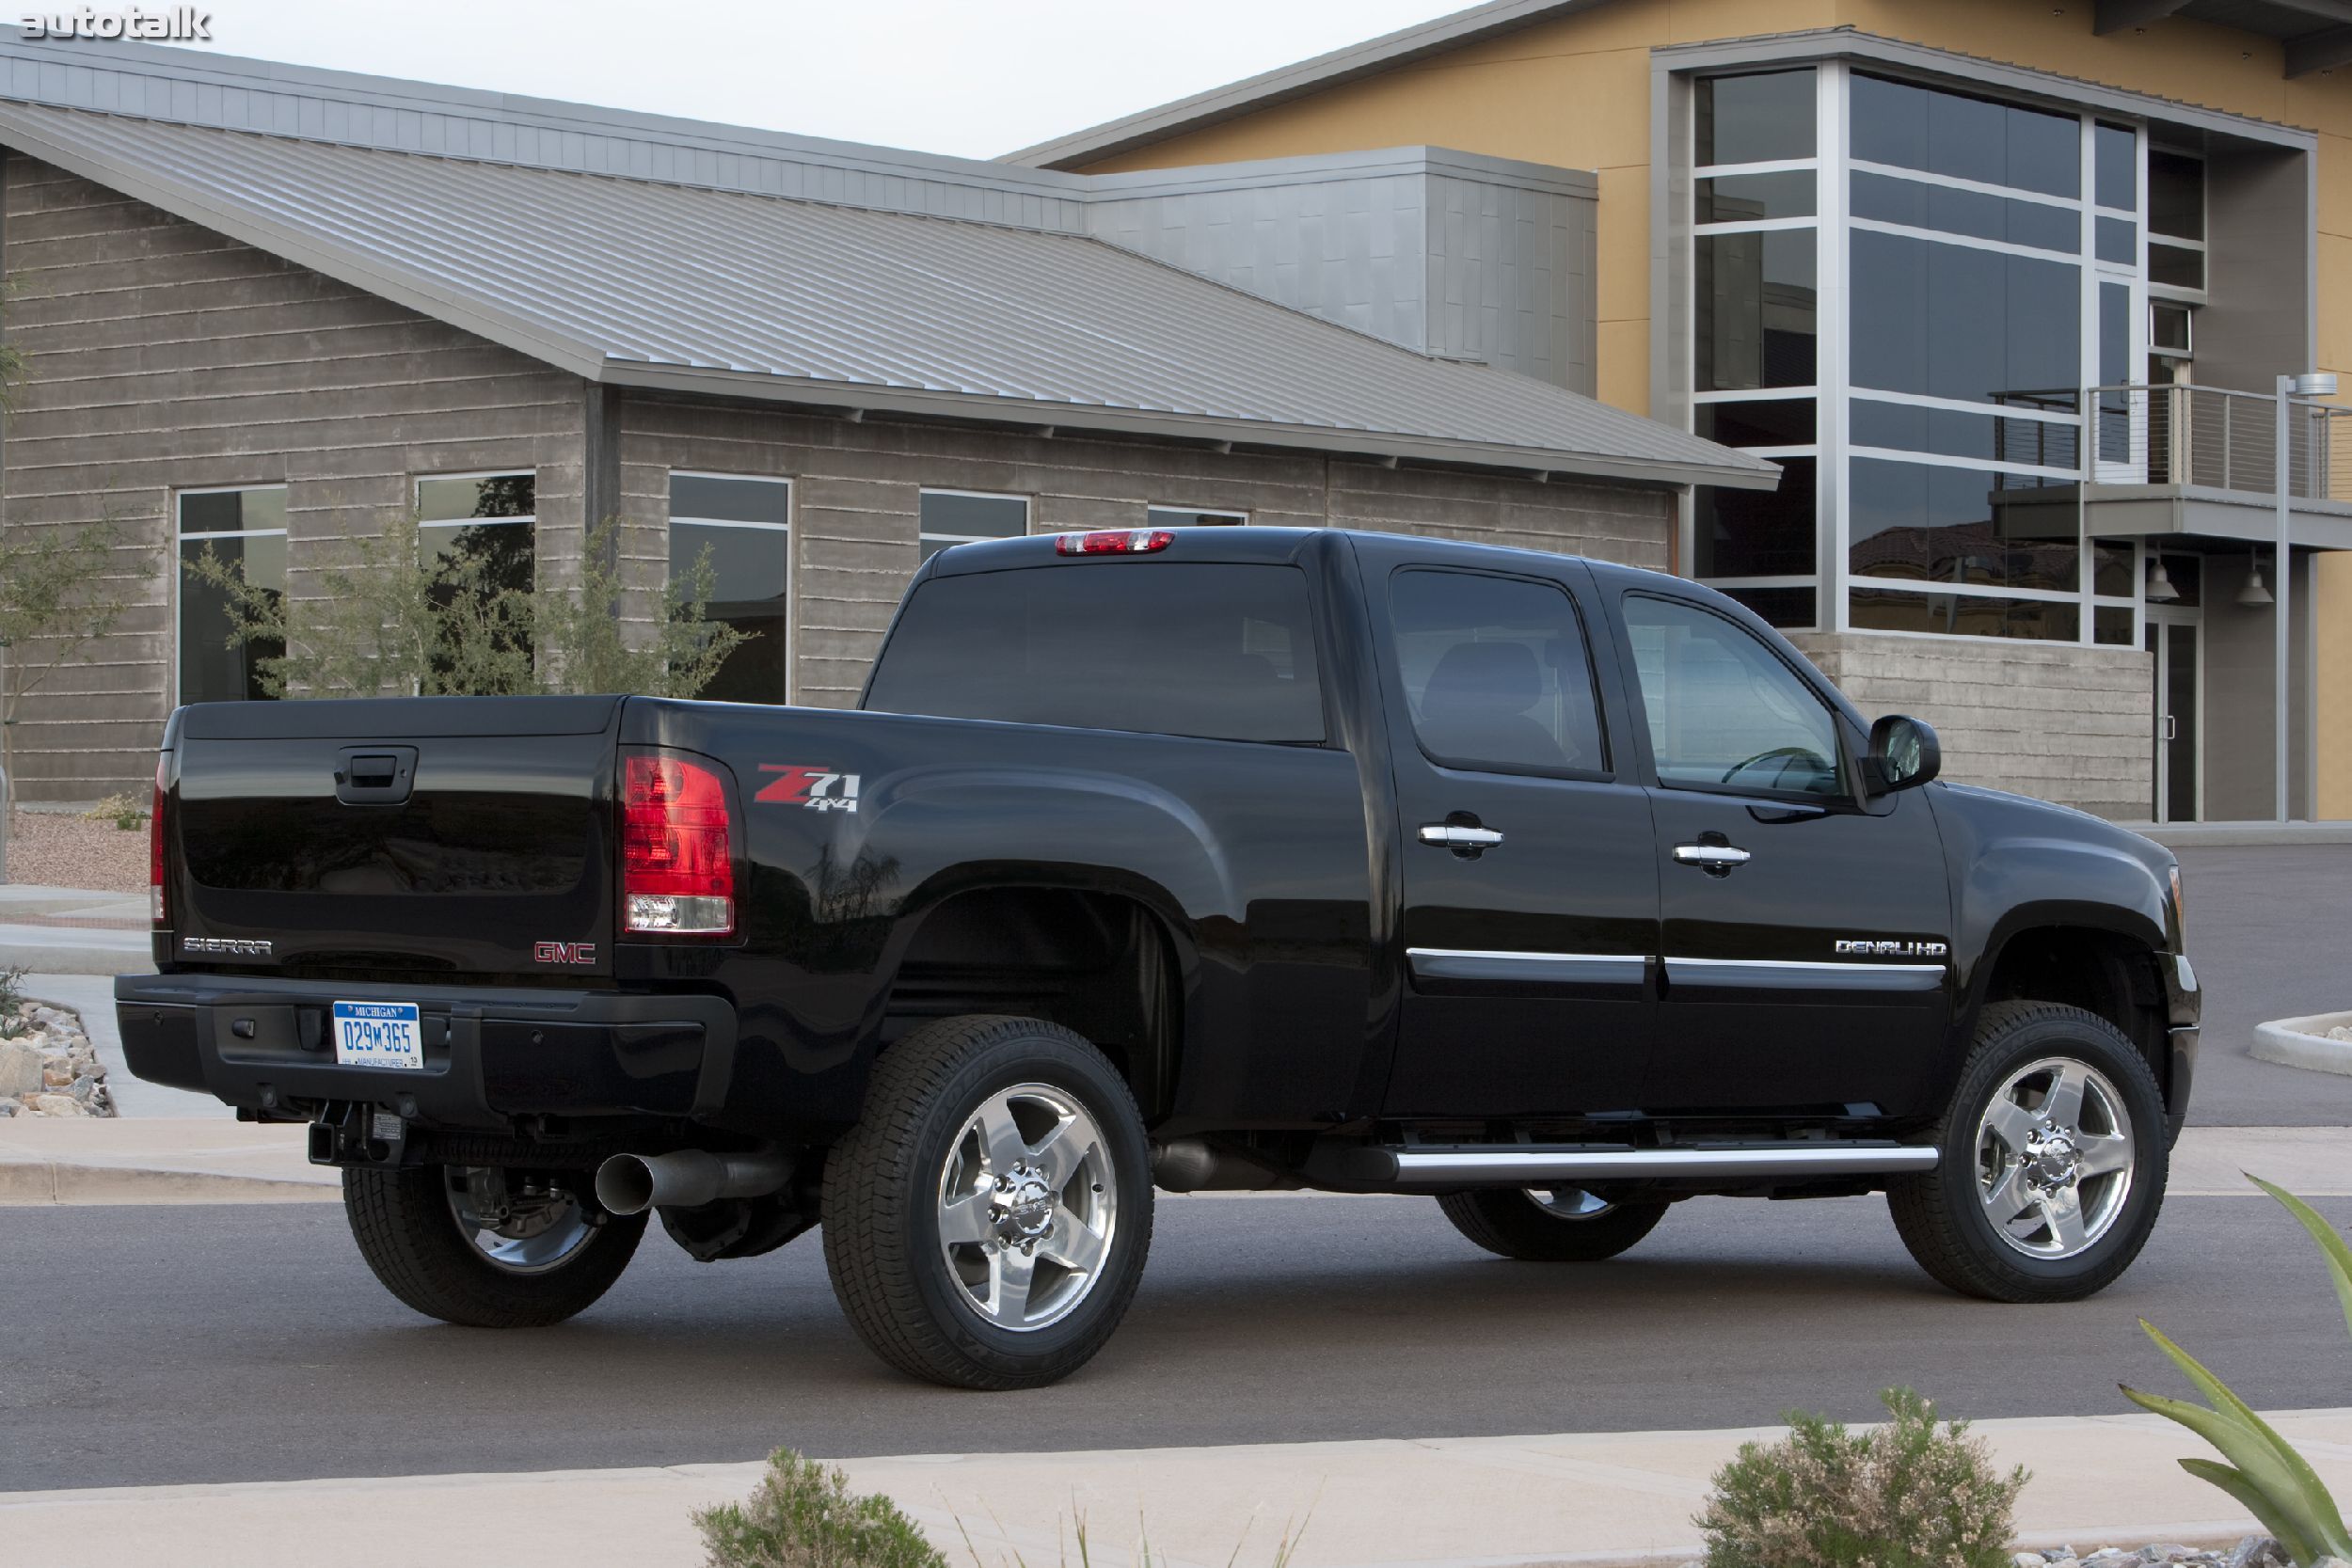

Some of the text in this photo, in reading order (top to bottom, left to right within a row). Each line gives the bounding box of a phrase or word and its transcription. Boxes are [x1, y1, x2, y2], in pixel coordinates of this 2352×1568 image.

[754, 764, 861, 804] Z71
[183, 937, 272, 955] SIERRA
[534, 941, 596, 965] GMC
[1836, 940, 1947, 956] DENALI HD
[355, 1006, 397, 1018] MICHIGAN
